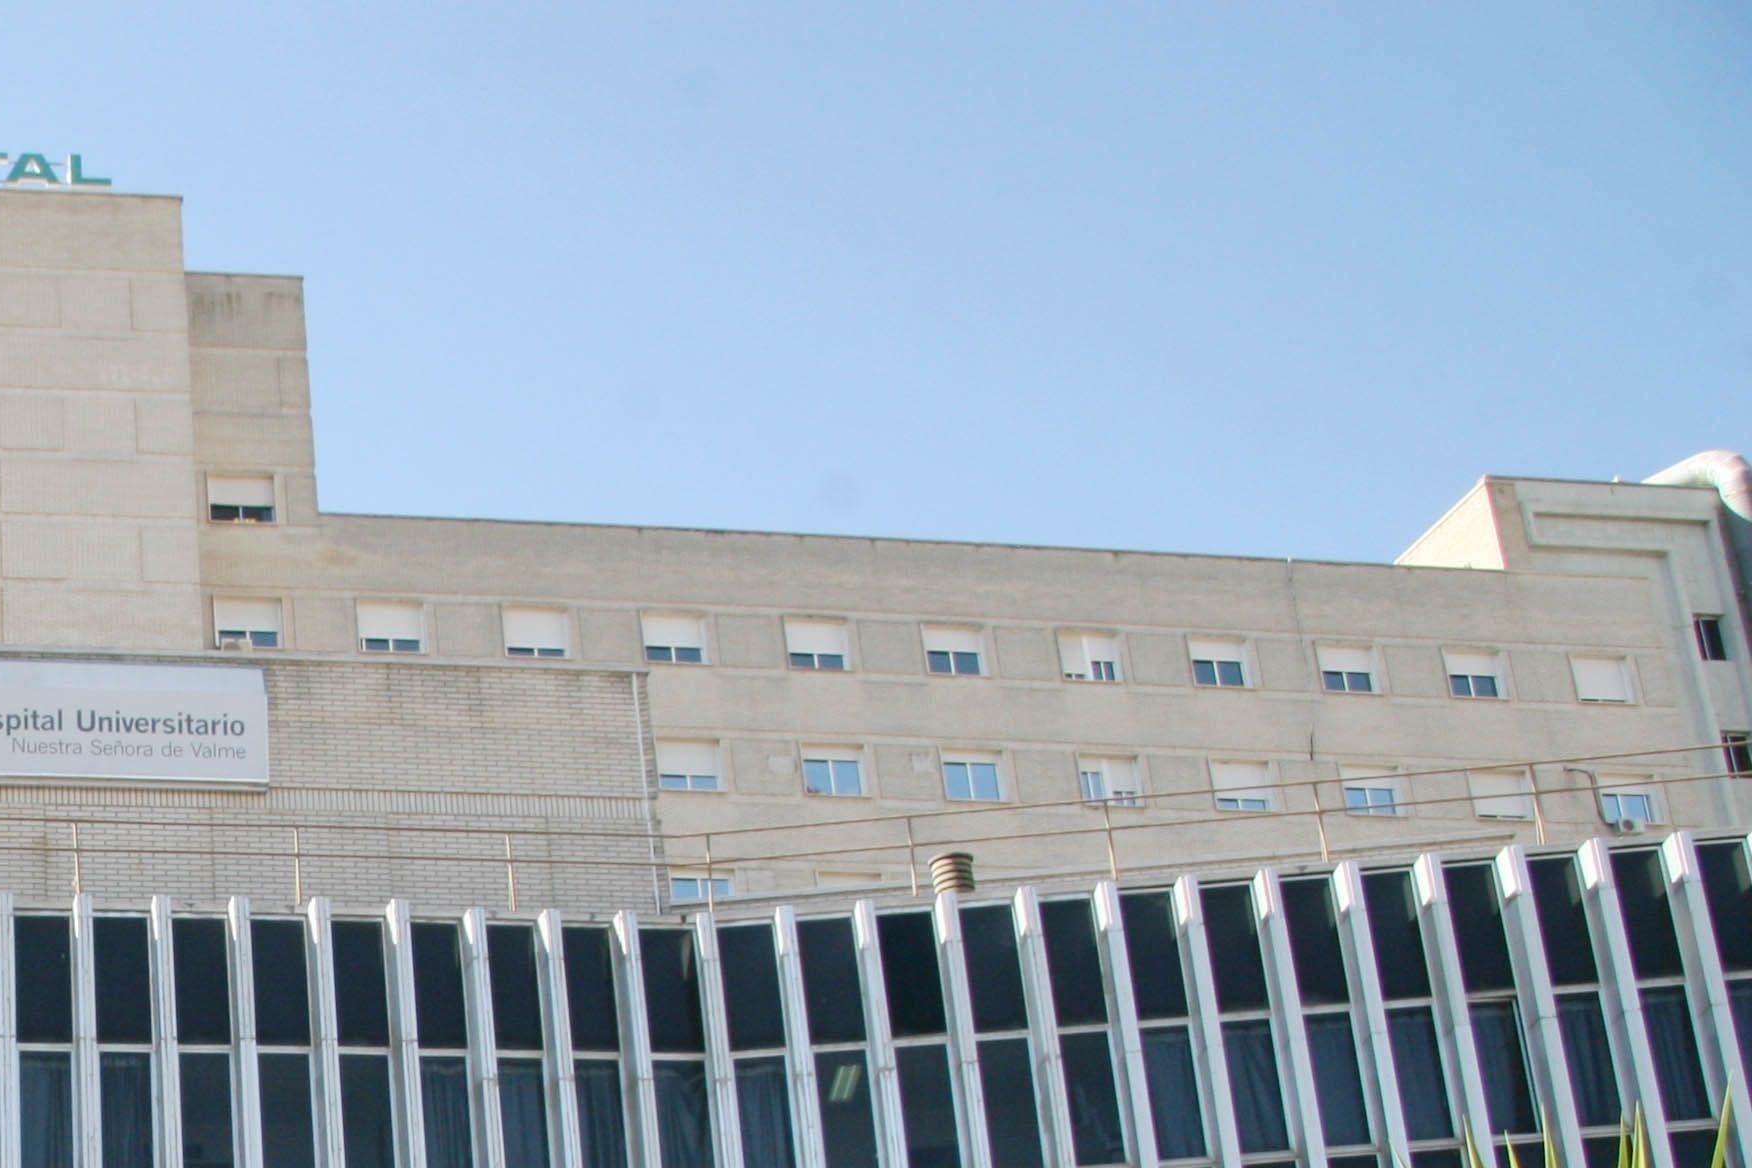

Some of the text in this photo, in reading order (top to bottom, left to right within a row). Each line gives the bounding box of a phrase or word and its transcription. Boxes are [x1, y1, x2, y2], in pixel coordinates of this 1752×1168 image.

[77, 708, 245, 737] Universitario
[12, 737, 248, 761] Nuestra Señora de Valme
